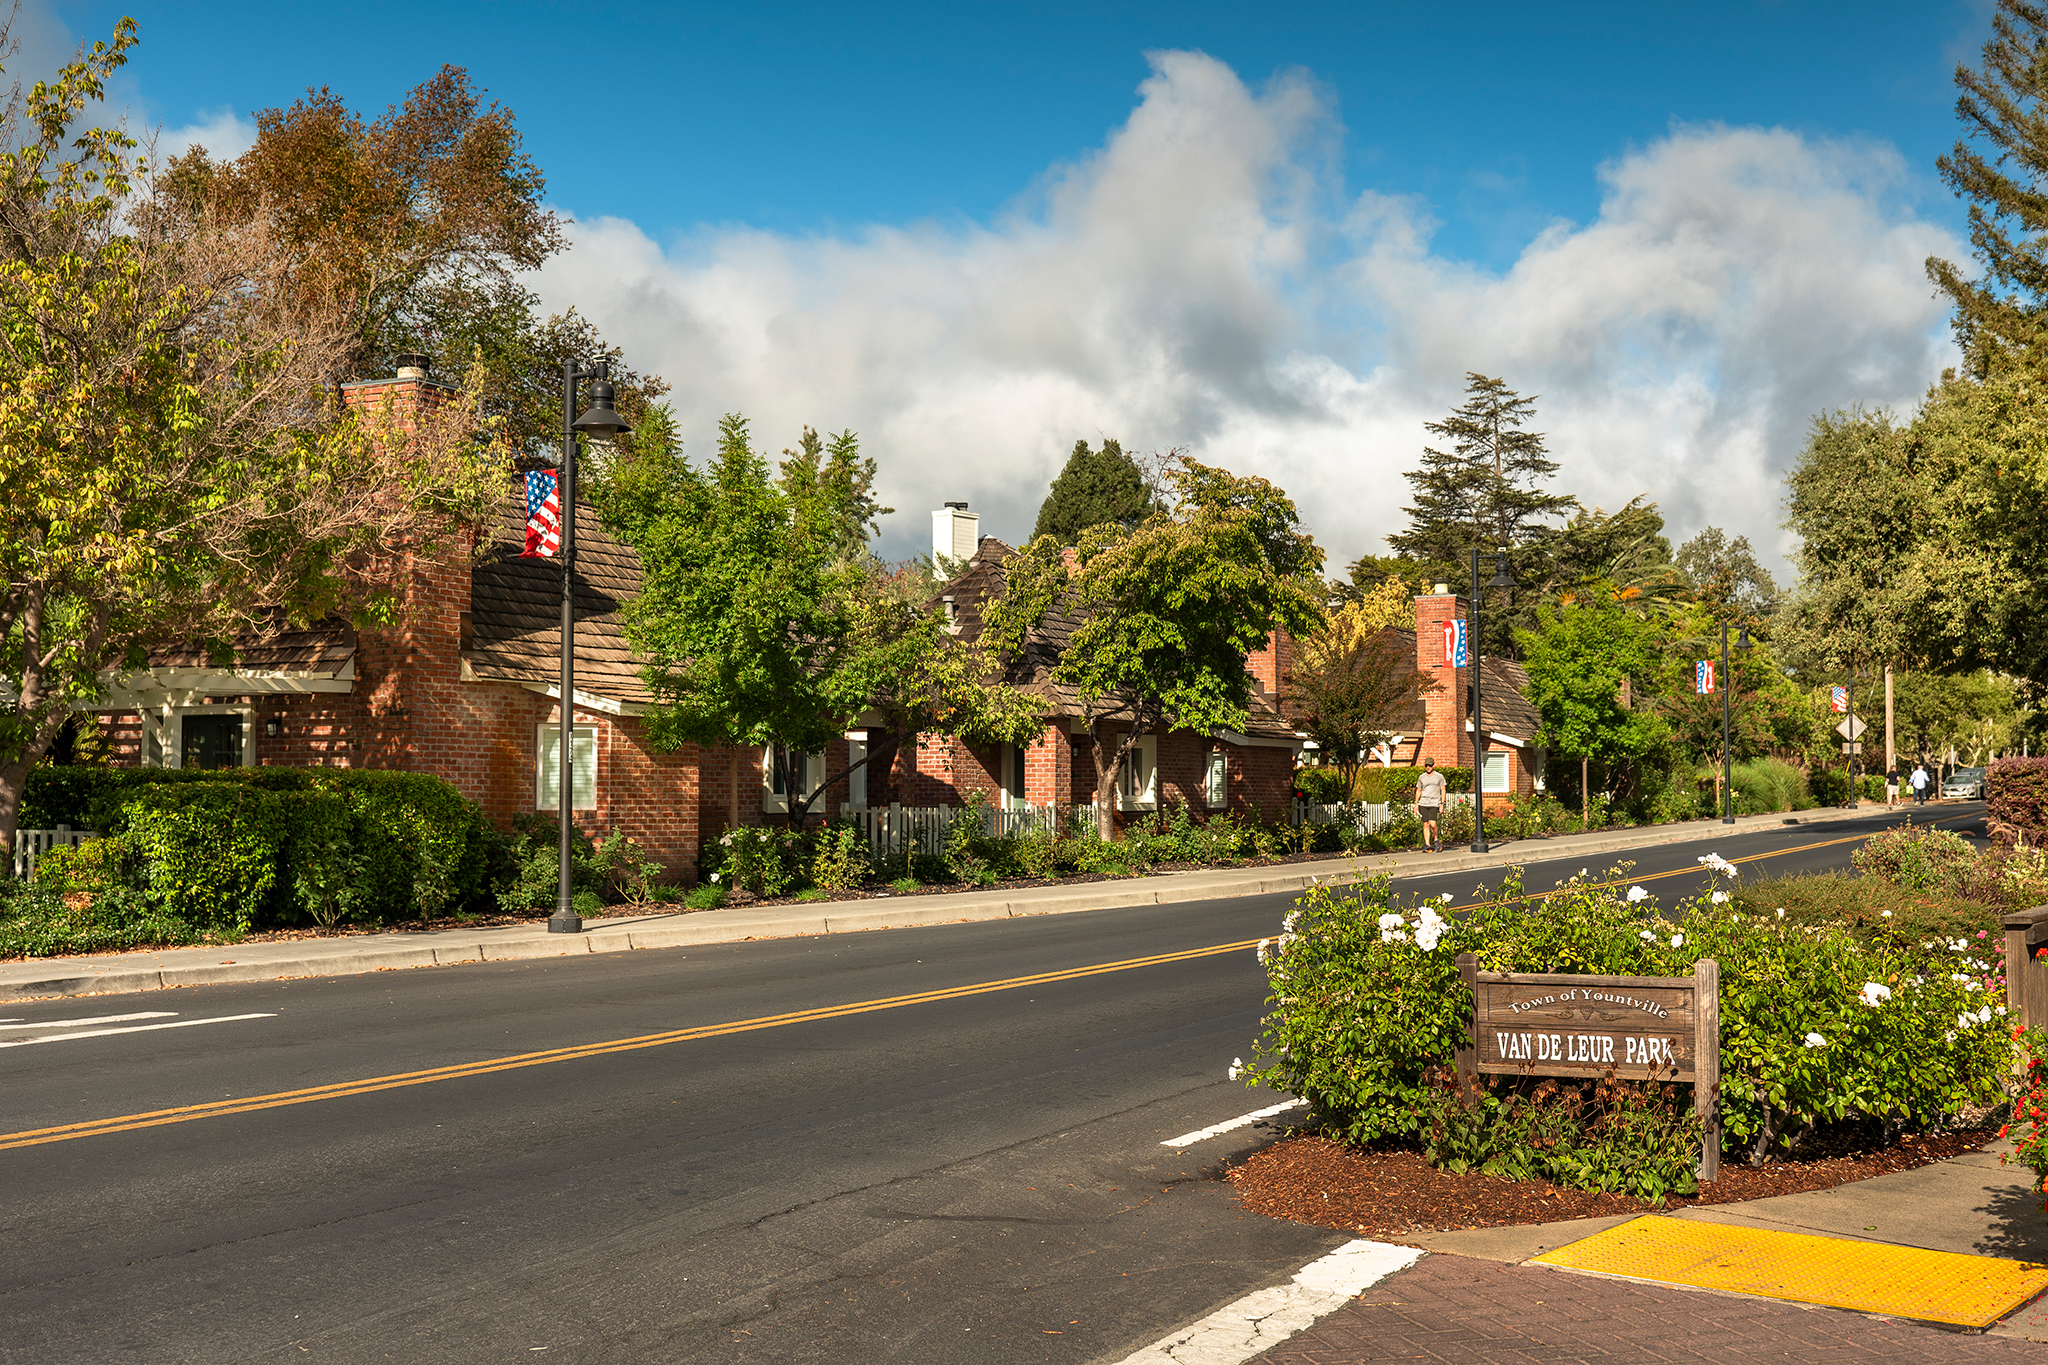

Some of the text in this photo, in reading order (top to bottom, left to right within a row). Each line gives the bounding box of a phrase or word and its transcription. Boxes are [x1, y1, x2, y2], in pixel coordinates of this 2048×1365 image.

[1508, 988, 1668, 1019] Town of Yountville
[1497, 1032, 1676, 1065] VAN DE LEUR PARK
